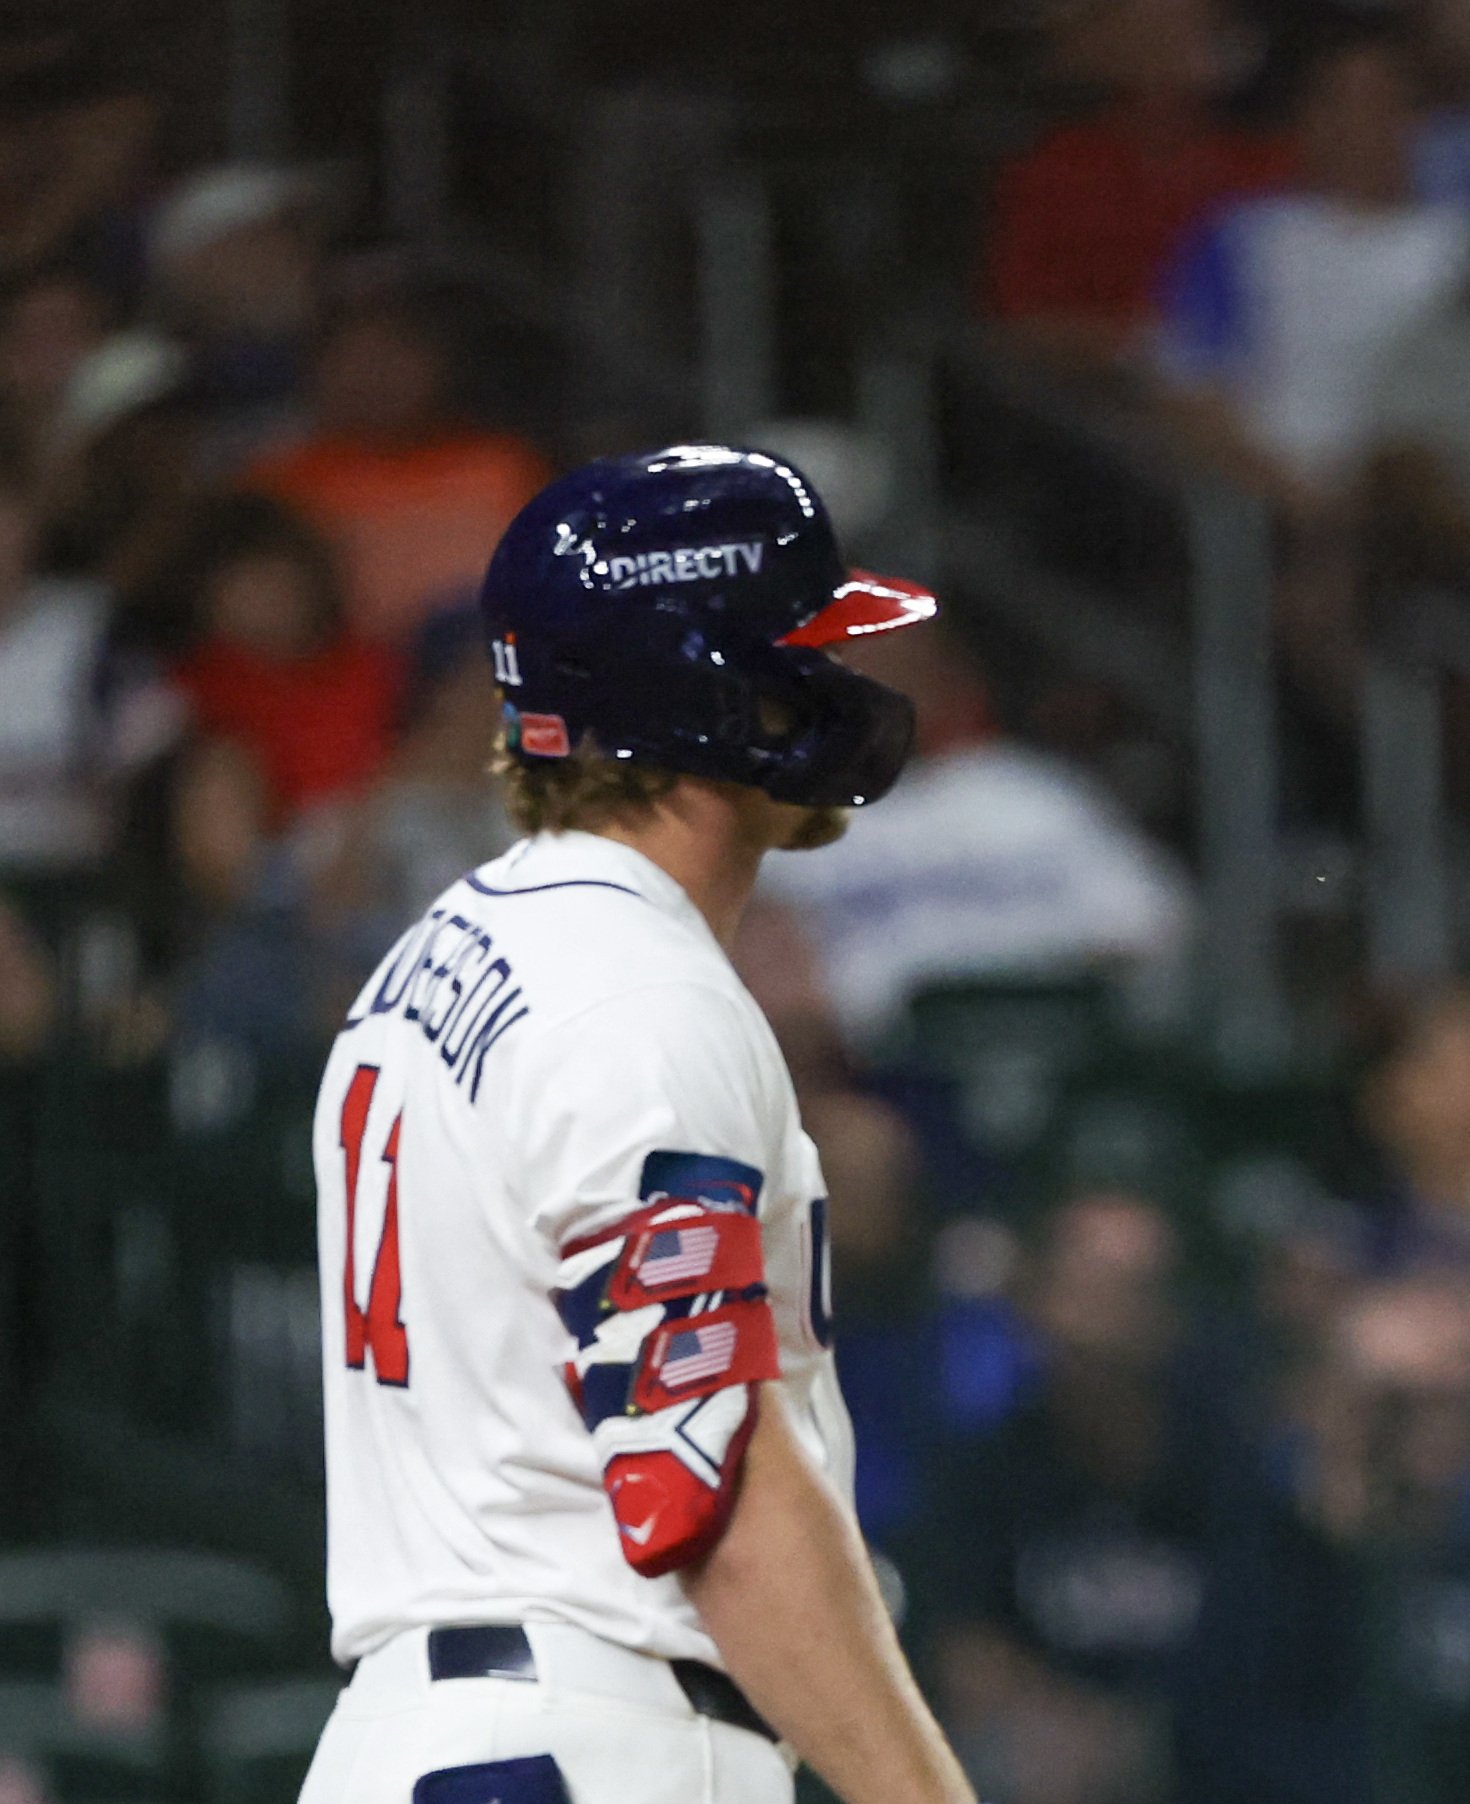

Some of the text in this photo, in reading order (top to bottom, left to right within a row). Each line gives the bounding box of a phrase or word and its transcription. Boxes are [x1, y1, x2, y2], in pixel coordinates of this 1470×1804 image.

[610, 542, 762, 590] DIRECTV
[491, 639, 523, 686] 11
[339, 1062, 409, 1388] 11
